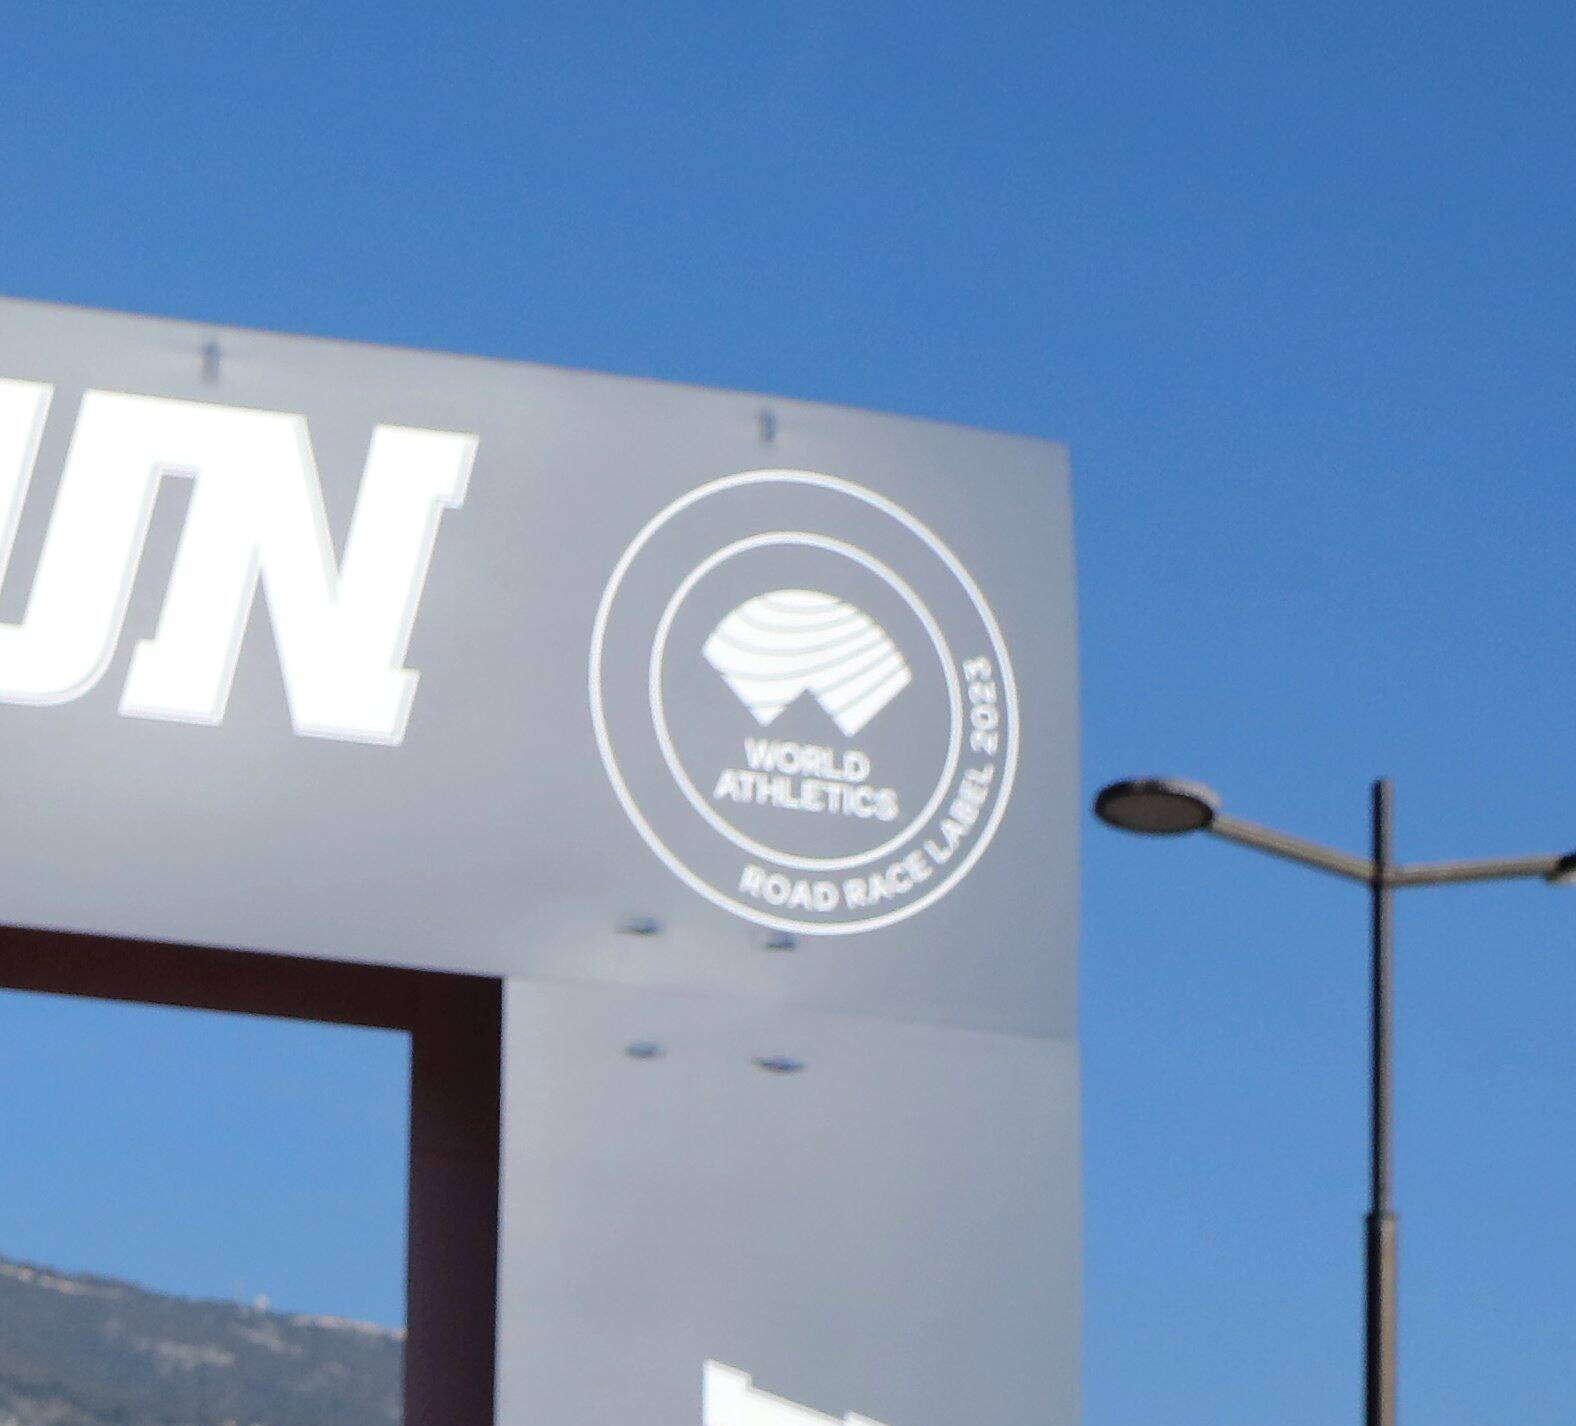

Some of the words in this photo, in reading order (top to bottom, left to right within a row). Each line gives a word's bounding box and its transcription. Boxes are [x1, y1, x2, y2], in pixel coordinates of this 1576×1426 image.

[738, 863, 839, 913] ROAD
[843, 851, 934, 910] RACE
[924, 764, 995, 865] LABEL
[962, 655, 999, 756] 2023
[744, 738, 871, 783] WORLD
[713, 768, 900, 823] ATHLETICS
